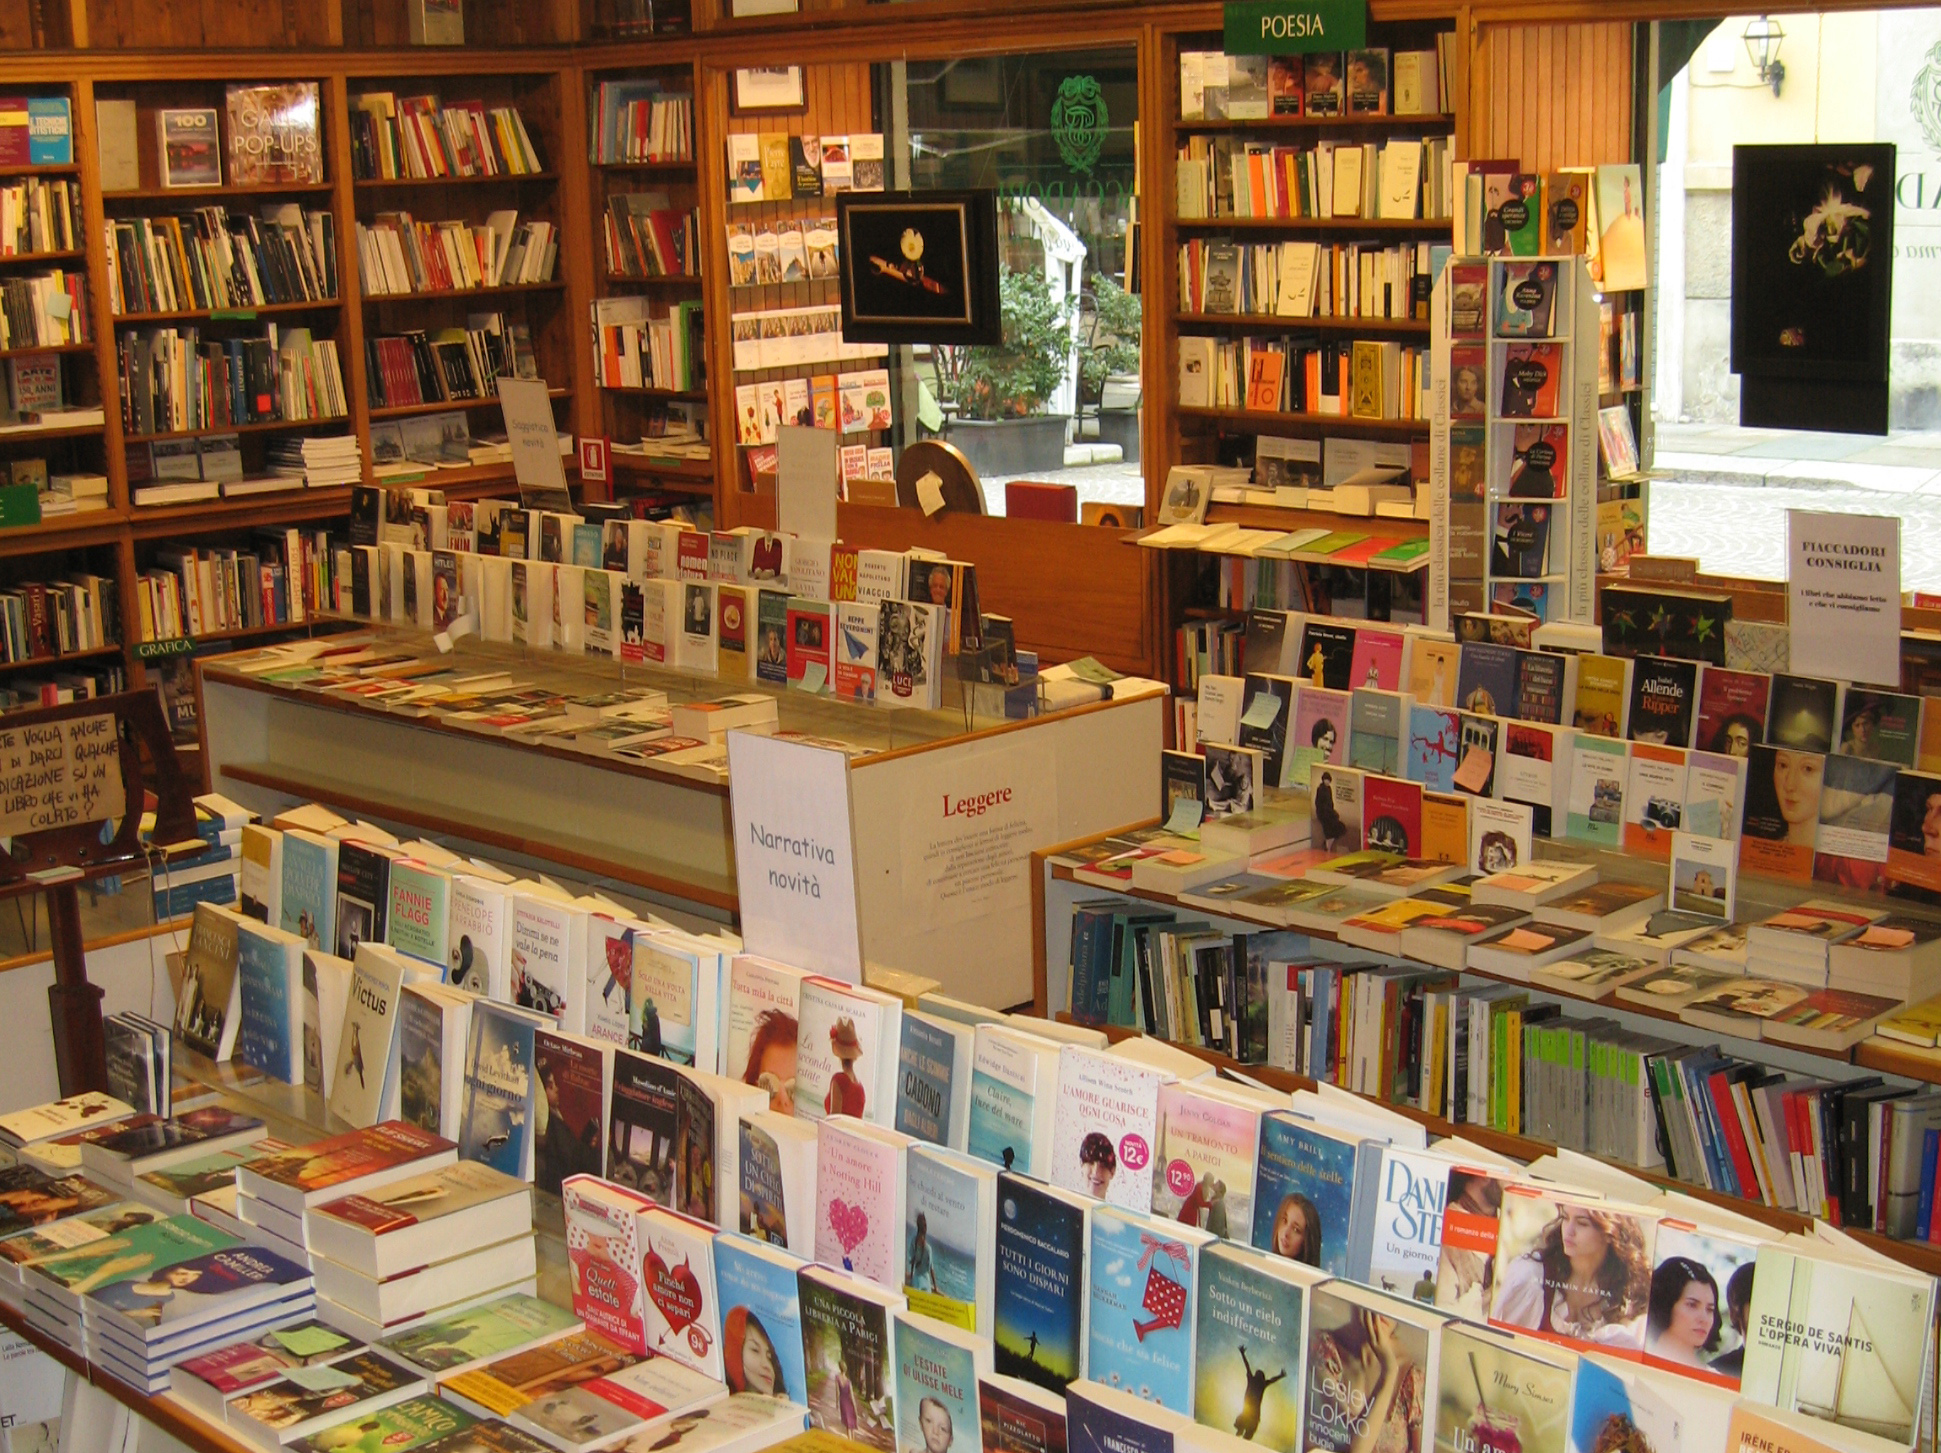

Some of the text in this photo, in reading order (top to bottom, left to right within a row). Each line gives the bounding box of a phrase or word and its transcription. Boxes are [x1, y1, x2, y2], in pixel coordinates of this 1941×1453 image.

[1261, 14, 1324, 38] POESIA
[1435, 380, 1446, 426] Classici
[1579, 383, 1591, 430] Classici
[1801, 541, 1887, 558] FIACCADORI
[1806, 557, 1882, 573] CONSIGLIA
[857, 586, 891, 598] VIAGGIO
[140, 640, 192, 657] GRAFICA
[1641, 679, 1683, 698] Allende
[1642, 696, 1680, 714] Ripper
[942, 787, 1013, 818] Leggere
[750, 822, 835, 866] Narrativa
[768, 867, 821, 899] novità
[393, 886, 432, 912] FANNIE
[395, 903, 429, 927] FLAGG
[516, 921, 559, 947] Dimmi se ne
[516, 939, 559, 963] vale la pena
[351, 974, 387, 1016] Victus
[752, 986, 766, 1000] mia
[768, 988, 775, 1002] la
[776, 993, 794, 1008] città
[486, 1081, 522, 1102] giorno
[905, 1070, 941, 1117] CADONO
[1063, 1083, 1149, 1119] L'AMORE GUARISCE
[1102, 1110, 1127, 1128] COSA
[1170, 1126, 1239, 1155] UN TRAMONTO
[830, 1147, 872, 1172] Un amore
[1192, 1151, 1221, 1168] PARIGI
[829, 1164, 882, 1194] Notting Hill
[1454, 1225, 1478, 1238] romanzo
[1386, 1241, 1434, 1263] Un giorno
[658, 1270, 685, 1292] Finché
[1002, 1261, 1065, 1298] SONO DISPARI
[1034, 1260, 1070, 1286] GIORNI
[588, 1285, 620, 1308] estate
[653, 1283, 695, 1309] amore non
[657, 1297, 691, 1320] ci separi
[1208, 1284, 1282, 1328] Sotto un cielo
[814, 1296, 866, 1326] UNA PICCOLA
[849, 1321, 878, 1344] PARIGI
[1212, 1305, 1277, 1345] indifferente
[1760, 1314, 1873, 1352] SERGIO DE SANTIS
[1758, 1328, 1842, 1357] L'OPERA VIVA
[913, 1353, 948, 1380] L'ESTATE
[912, 1368, 941, 1393] ULISSE
[942, 1382, 963, 1401] MELE
[1311, 1365, 1375, 1417] Lesley
[1493, 1370, 1519, 1396] Mary
[1, 1414, 17, 1428] ET
[1310, 1391, 1370, 1439] Lokko
[1453, 1426, 1475, 1452] Un
